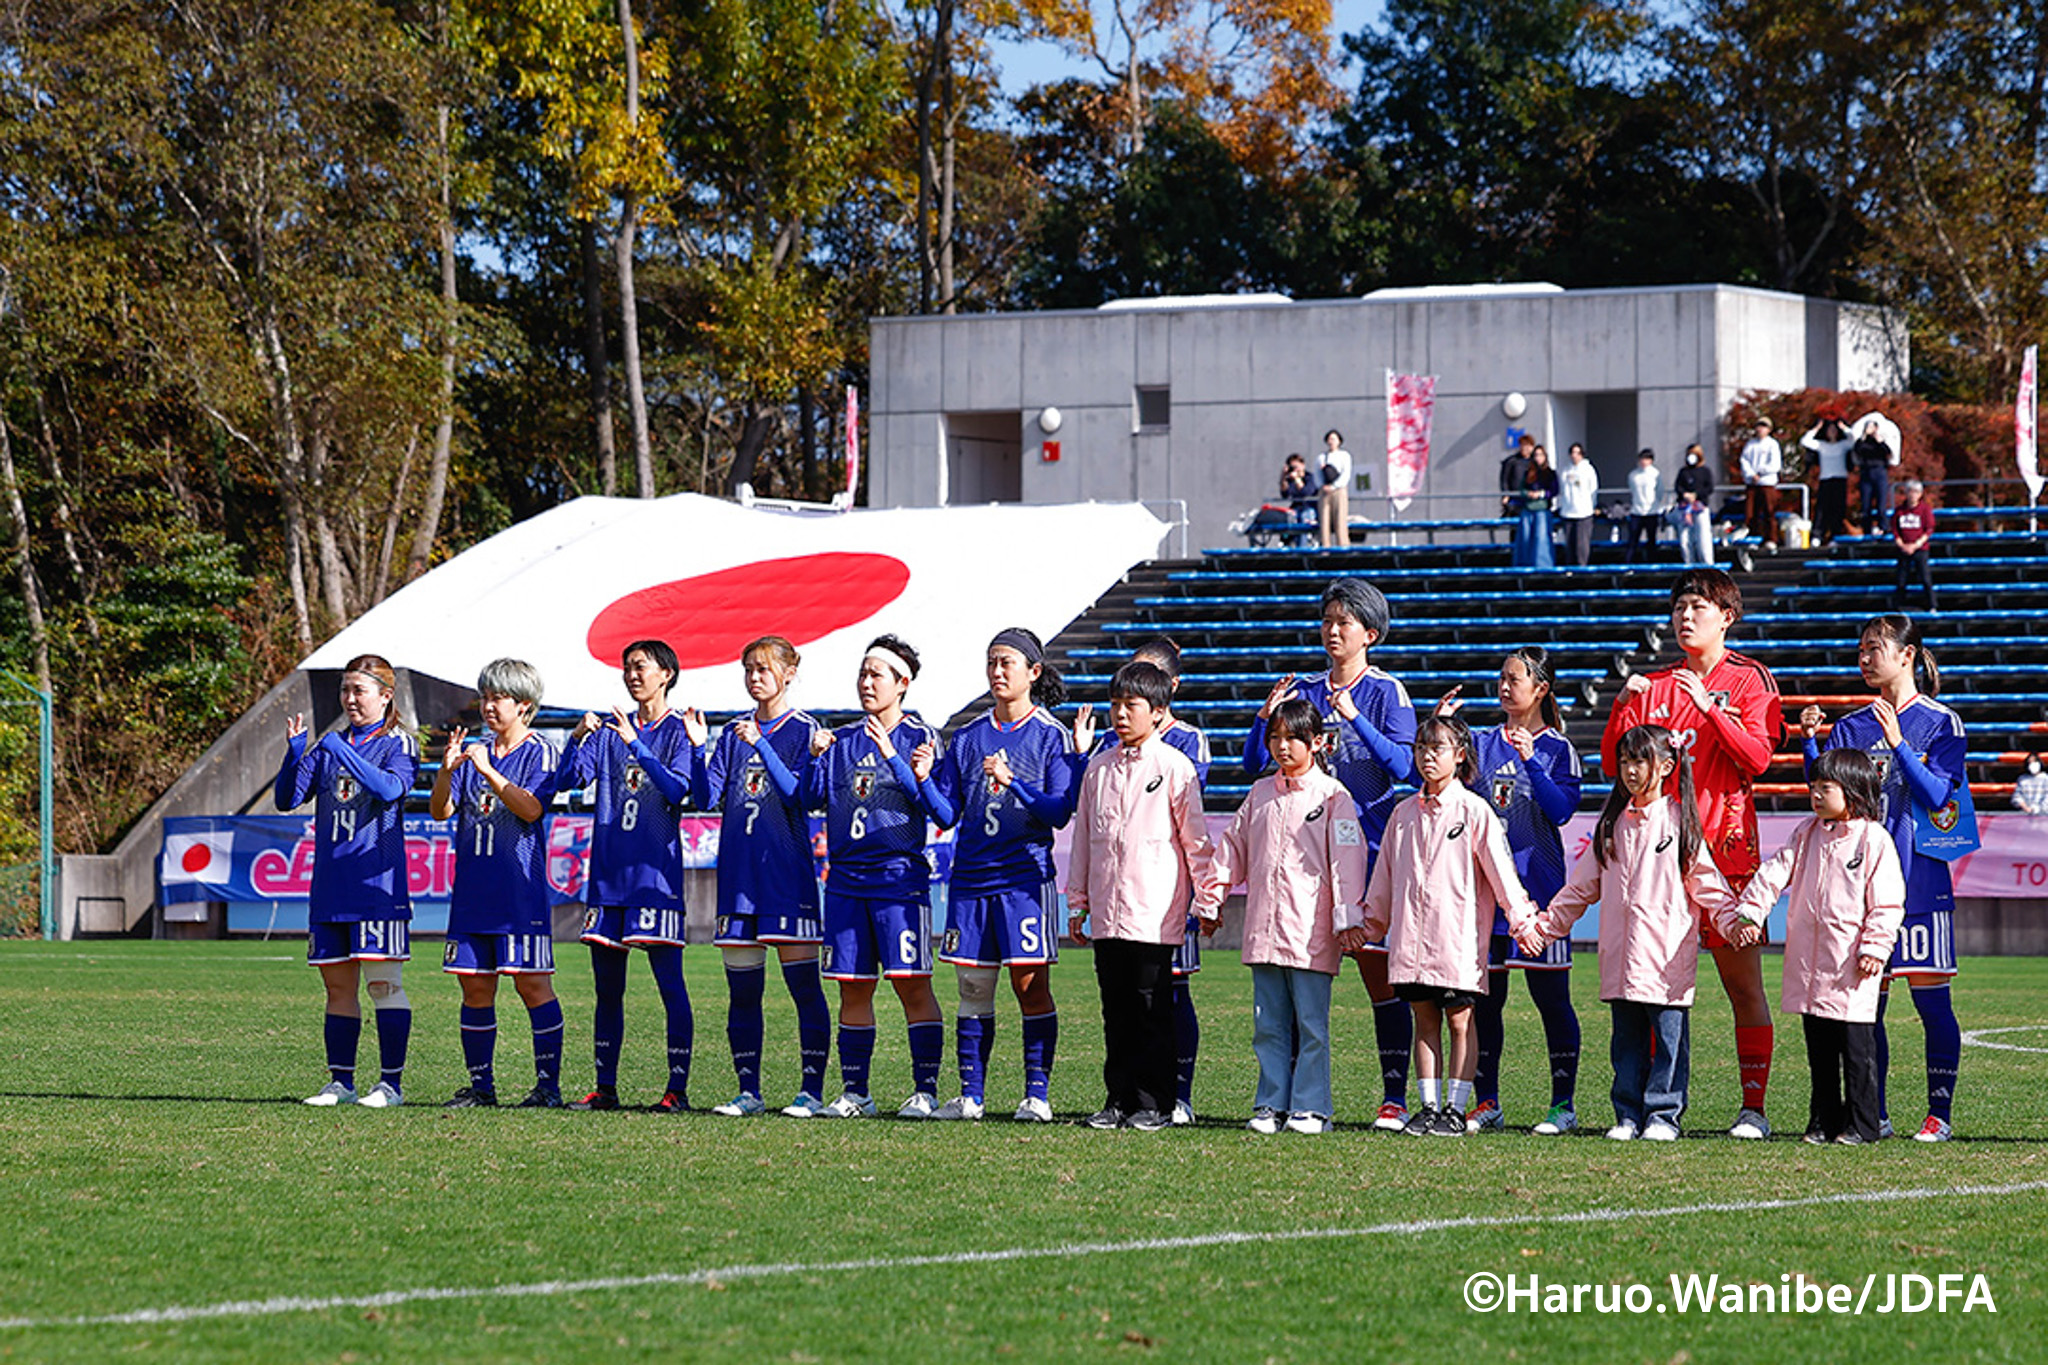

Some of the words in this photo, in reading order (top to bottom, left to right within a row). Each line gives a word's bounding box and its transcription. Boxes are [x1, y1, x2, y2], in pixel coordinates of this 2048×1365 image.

[331, 810, 356, 842] 14
[622, 798, 639, 831] 8
[744, 801, 760, 835] 7
[850, 806, 868, 840] 6
[985, 801, 1002, 836] 5
[475, 823, 494, 856] 11
[360, 920, 384, 949] 14
[507, 934, 531, 963] 11
[899, 929, 918, 964] 6
[1020, 917, 1038, 952] 5
[1898, 924, 1930, 963] 10
